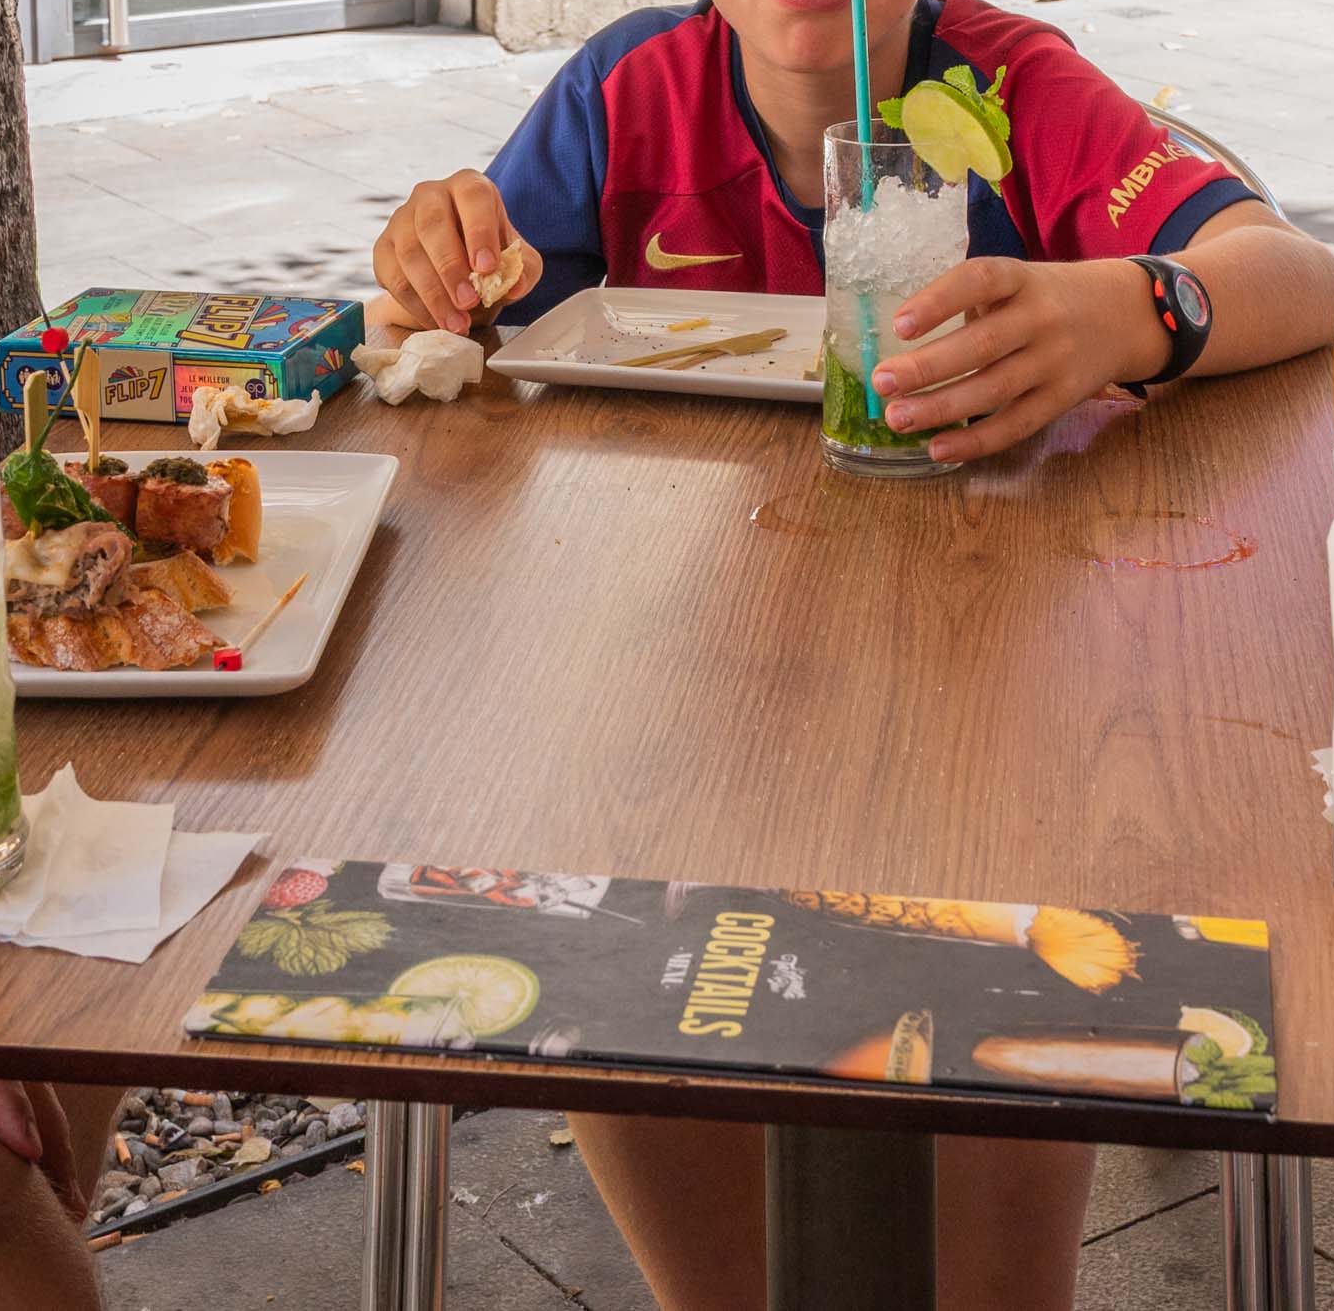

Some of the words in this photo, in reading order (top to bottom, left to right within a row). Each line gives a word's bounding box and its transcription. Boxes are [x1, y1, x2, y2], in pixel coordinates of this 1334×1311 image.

[189, 375, 196, 383] LE
[198, 376, 230, 384] MEILLEUR
[678, 911, 775, 1038] COCKTAILS
